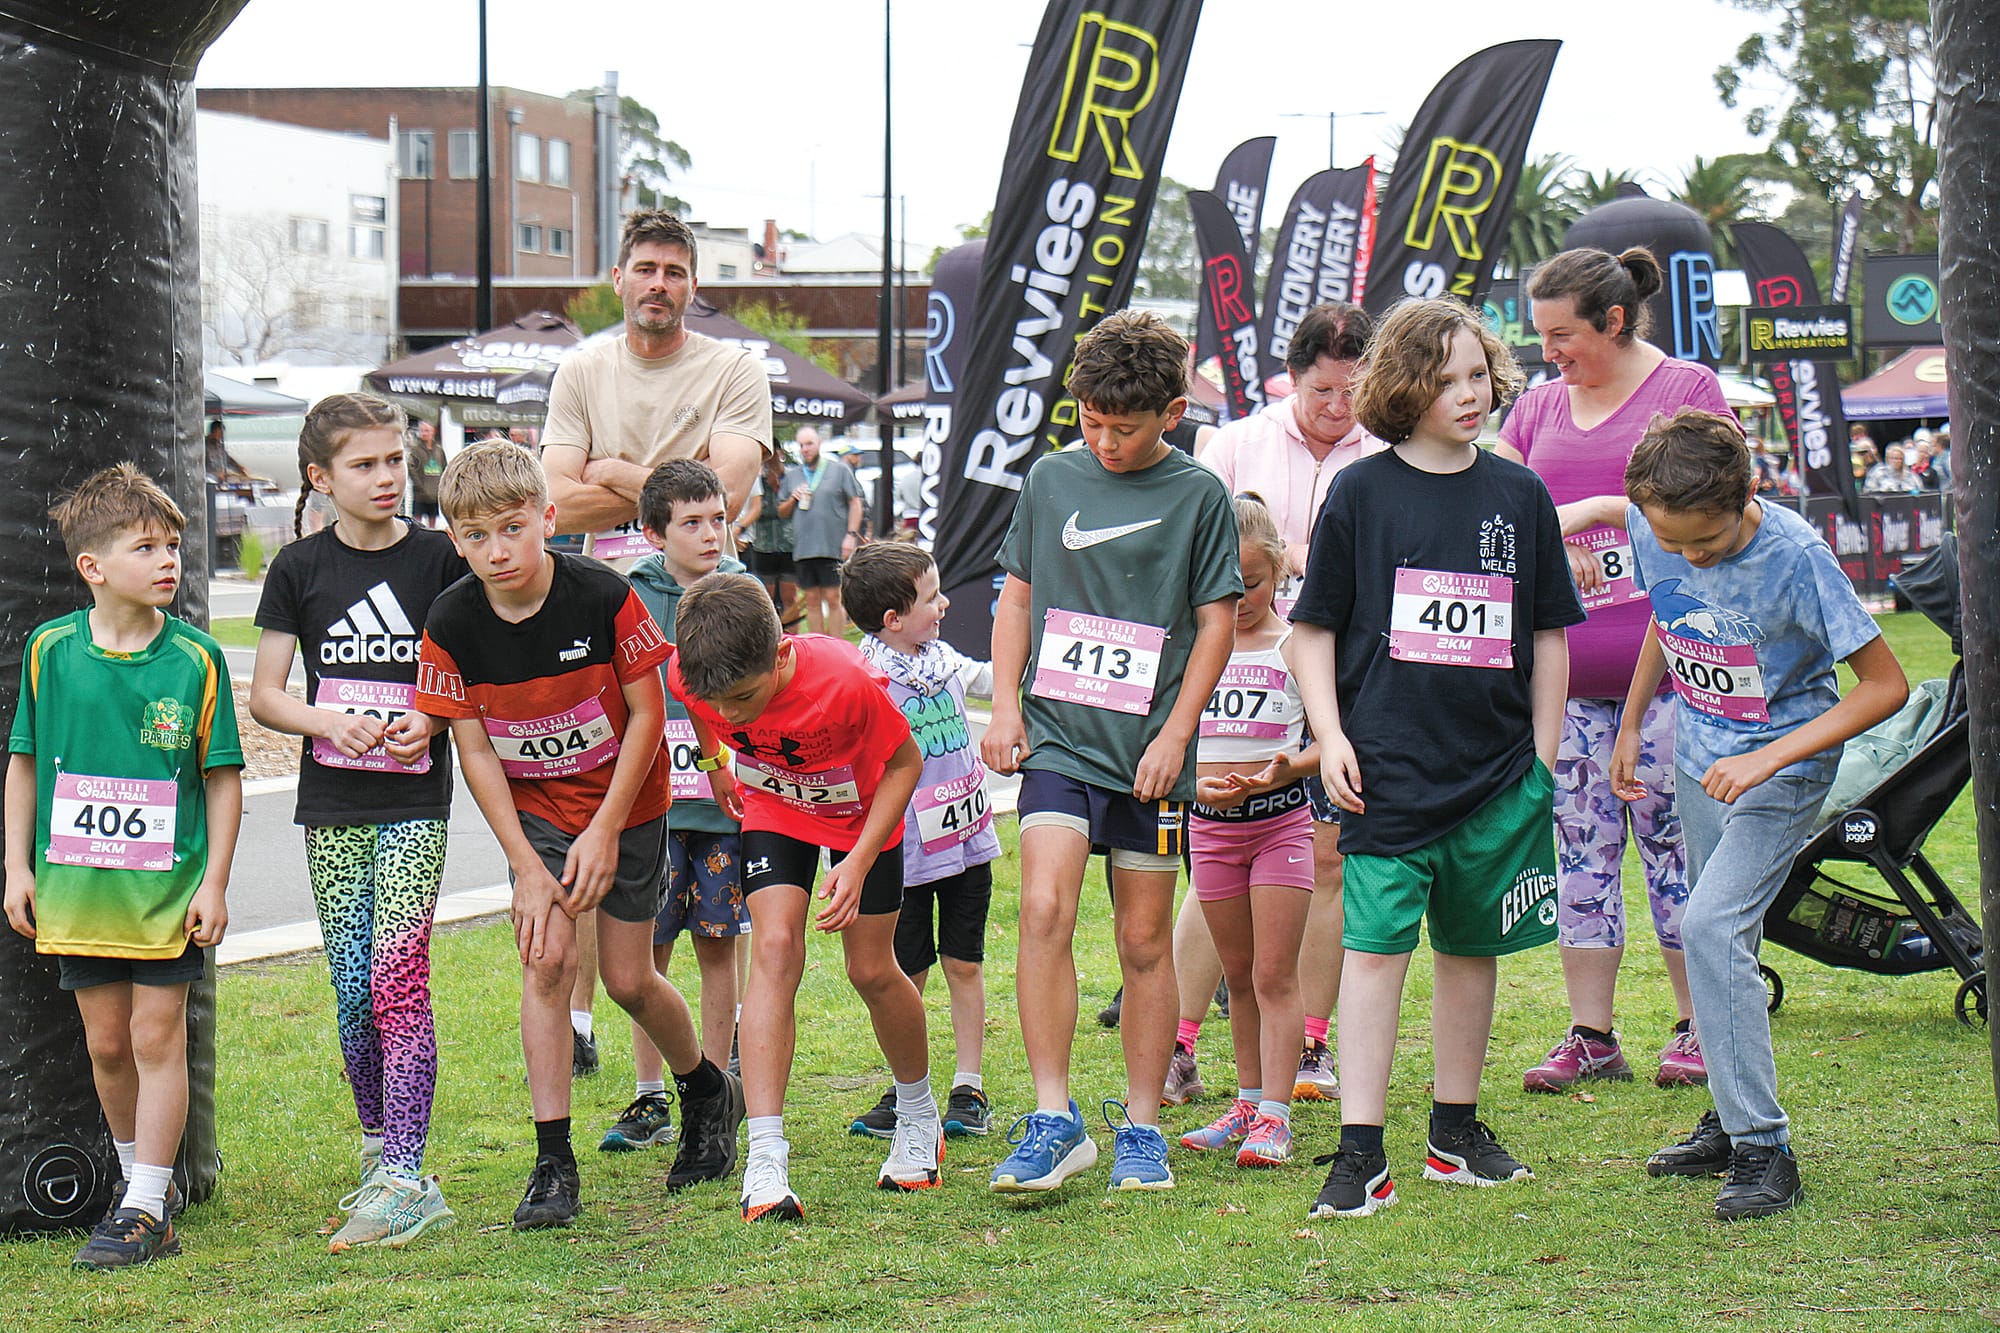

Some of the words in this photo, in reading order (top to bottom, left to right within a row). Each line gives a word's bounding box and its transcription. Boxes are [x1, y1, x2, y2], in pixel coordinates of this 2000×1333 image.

[1047, 11, 1159, 180] R
[1404, 136, 1501, 261] R
[1316, 200, 1358, 305] OVERY
[1270, 200, 1326, 360] RECOVERY
[1205, 253, 1252, 331] R
[1669, 250, 1722, 361] R
[964, 178, 1096, 491] Revvies
[1774, 316, 1848, 338] Revvies
[1789, 359, 1832, 470] evvies
[1479, 520, 1493, 558] SIMS
[1494, 513, 1504, 527] &
[1504, 523, 1516, 561] FINN
[1591, 538, 1619, 550] TRAIL
[1481, 558, 1517, 574] MELB
[1439, 585, 1463, 596] RAIL
[1463, 586, 1491, 598] TRAIL
[1419, 599, 1486, 635] 401
[1083, 628, 1106, 639] RAIL
[1107, 631, 1137, 645] TRAIL
[1436, 637, 1473, 651] 2KM
[559, 647, 588, 662] PUMA
[1062, 641, 1131, 680] 413
[1407, 650, 1428, 660] BAG
[1430, 652, 1449, 662] TAG
[1451, 654, 1471, 663] 2KM
[1679, 646, 1699, 658] RAIL
[1699, 651, 1729, 664] TRAIL
[416, 660, 465, 702] MA
[1240, 676, 1269, 685] TRAIL
[1675, 656, 1734, 694] 400
[1074, 677, 1109, 694] 2KM
[353, 692, 378, 703] RAIL
[378, 694, 409, 706] TRAIL
[1048, 688, 1067, 698] BAG
[1068, 691, 1085, 701] TAG
[1085, 695, 1106, 705] 2KM
[1205, 689, 1268, 719] 407
[1691, 689, 1721, 706] 2KM
[525, 727, 549, 737] RAIL
[549, 719, 580, 732] TRAIL
[1216, 722, 1249, 734] 2KM
[140, 728, 192, 750] PARROTS
[519, 728, 589, 760] 404
[346, 759, 362, 767] TAG
[364, 760, 386, 769] 2KM
[543, 757, 577, 770] 2KM
[91, 789, 116, 800] RAIL
[117, 790, 149, 802] TRAIL
[762, 776, 832, 804] 412
[949, 788, 968, 800] RAIL
[941, 789, 985, 831] 410
[1192, 800, 1243, 817] NIKE
[1248, 787, 1302, 816] PRO
[74, 804, 147, 839] 406
[1845, 822, 1867, 835] baby
[958, 822, 981, 841] 2KM
[1845, 832, 1875, 843] jogger
[89, 840, 127, 855] 2KM
[64, 854, 82, 863] BAG
[84, 856, 102, 864] TAG
[1501, 874, 1556, 936] CELTICS
